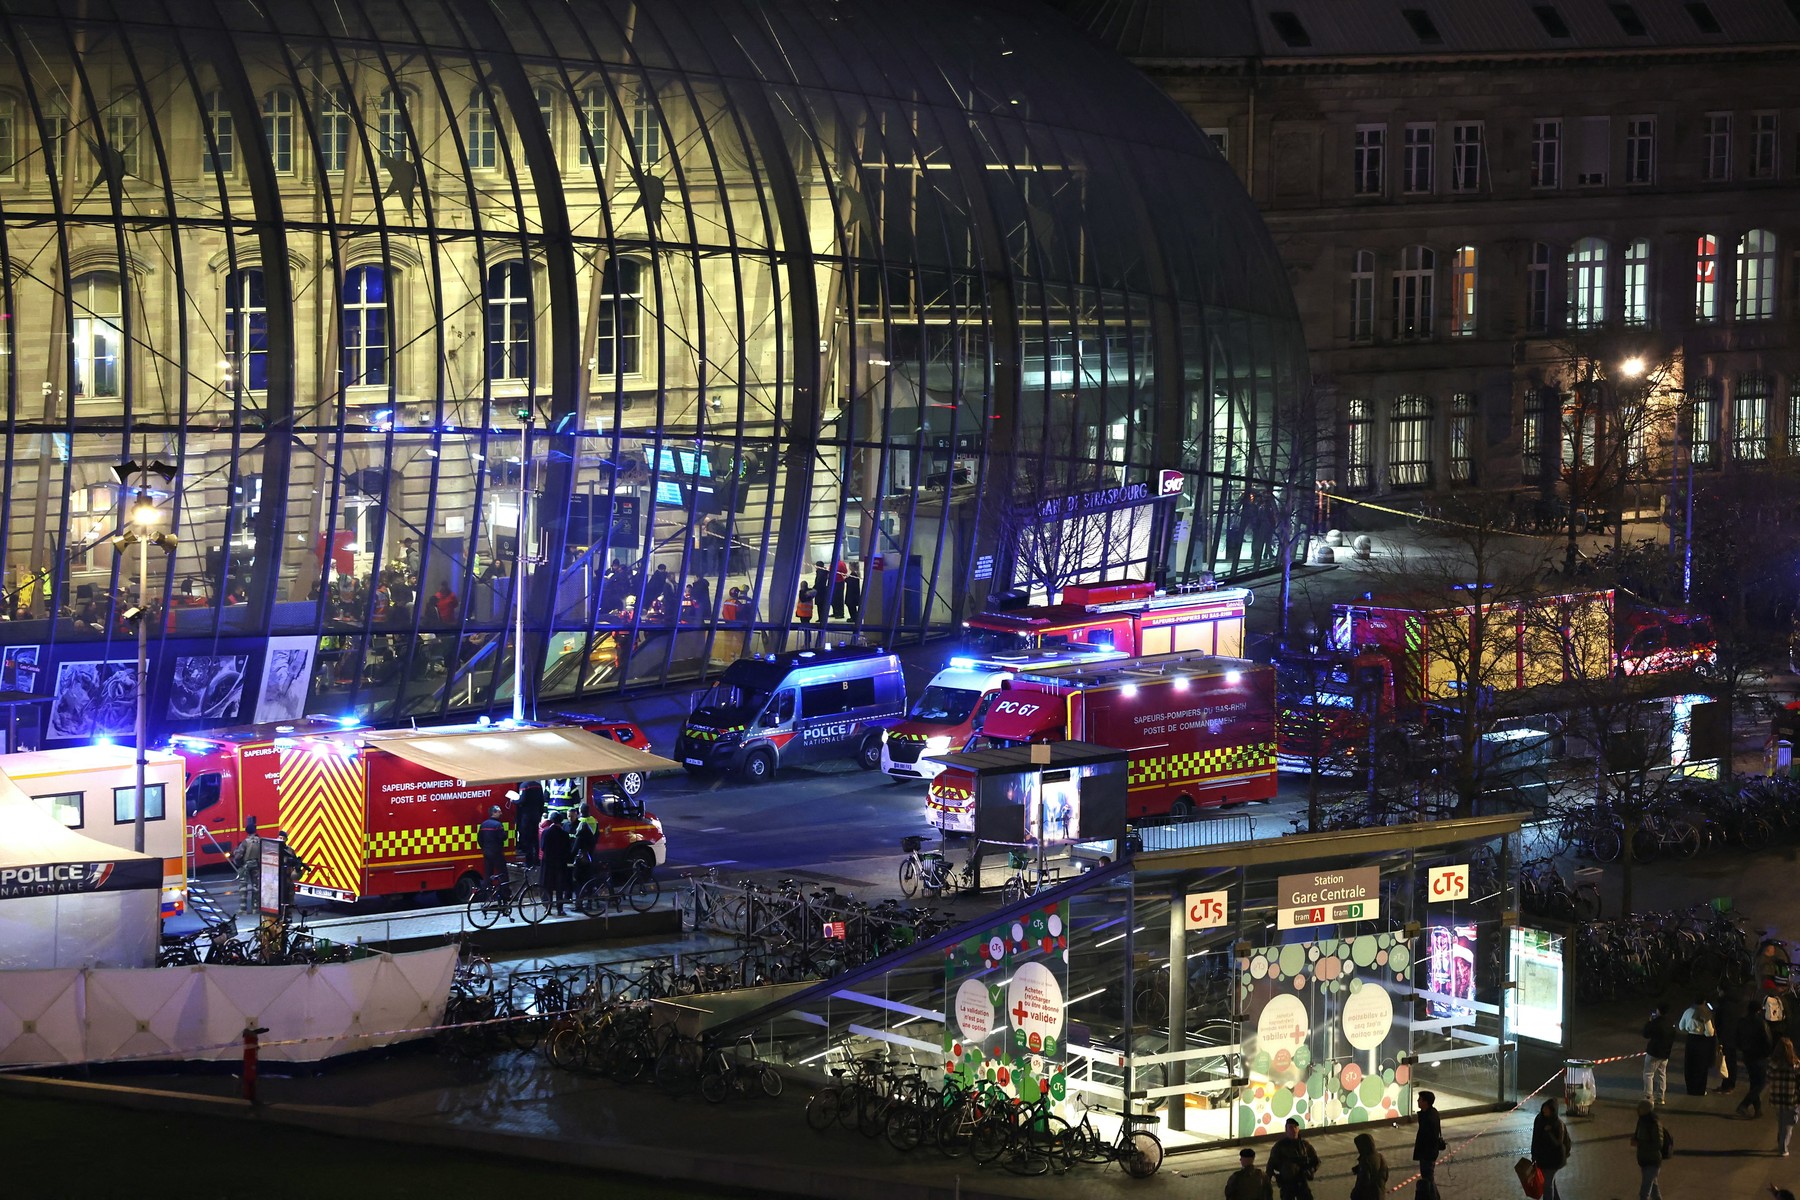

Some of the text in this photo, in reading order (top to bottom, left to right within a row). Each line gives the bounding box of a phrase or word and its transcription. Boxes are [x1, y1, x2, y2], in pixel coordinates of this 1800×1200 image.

[1163, 476, 1185, 493] SNCF
[1084, 482, 1149, 509] STRASBOURG
[1201, 612, 1209, 620] DU
[1209, 610, 1233, 619] BAS-RHIN
[842, 681, 849, 690] B
[995, 701, 1040, 717] PC 67
[1133, 708, 1202, 725] SAPEURS-POMPIERS
[803, 724, 848, 739] POLICE
[1143, 716, 1237, 736] POSTE DE COMMANDEMENT
[803, 735, 845, 747] NATIONALE
[382, 780, 454, 792] SAPEURS-POMPIERS
[391, 796, 414, 804] POSTE
[430, 789, 492, 802] COMMANDEMENT
[1, 864, 84, 885] POLICE
[1314, 874, 1344, 886] Station
[1, 882, 84, 896] NATIONALE
[1292, 885, 1366, 905] Gare Centrale
[1312, 910, 1322, 921] A
[1333, 904, 1361, 918] tram D
[1030, 1012, 1057, 1025] valider
[1053, 1081, 1064, 1093] CTS
